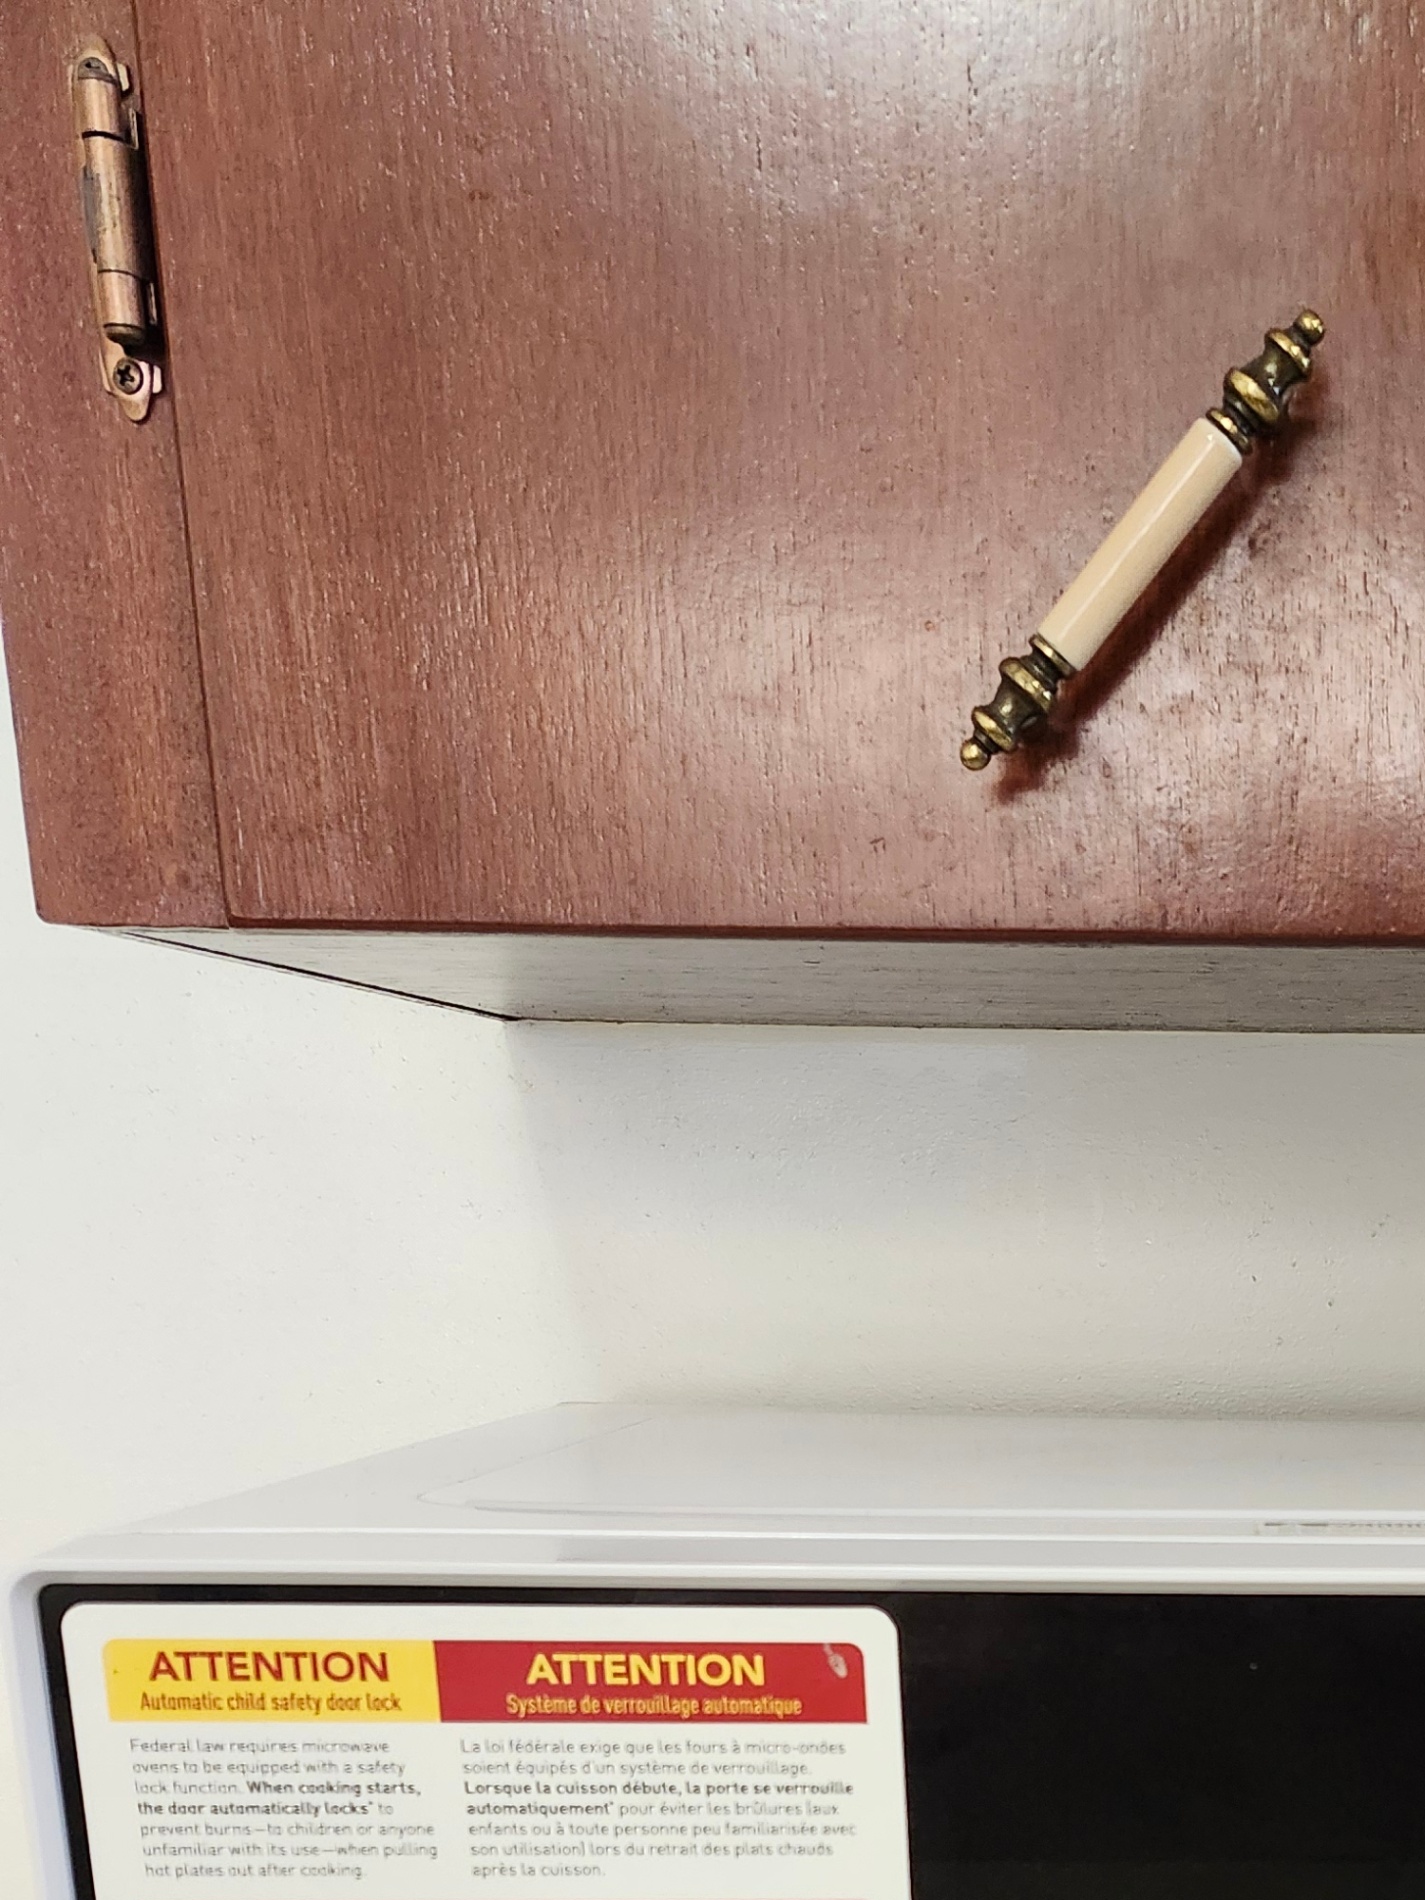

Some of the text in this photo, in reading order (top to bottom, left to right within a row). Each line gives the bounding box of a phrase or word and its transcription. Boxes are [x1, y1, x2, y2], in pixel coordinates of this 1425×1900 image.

[149, 1650, 389, 1683] ATTENTION
[526, 1653, 765, 1687] ATTENTION
[140, 1691, 403, 1716] Automatic child safety door lock
[505, 1692, 802, 1719] Système de verrouillage automatique
[129, 1738, 390, 1755] Federal law requires microwave
[132, 1759, 406, 1778] ovens to be equipped with a safety
[134, 1781, 167, 1794] lock
[245, 1780, 294, 1795] When
[297, 1780, 362, 1798] cooking
[366, 1781, 422, 1796] starts,
[463, 1780, 854, 1798] Lorsque la cuisson débute, la porte se verrouille
[137, 1801, 164, 1815] the
[167, 1801, 206, 1815] door
[210, 1801, 322, 1818] automatically
[377, 1804, 393, 1815] to
